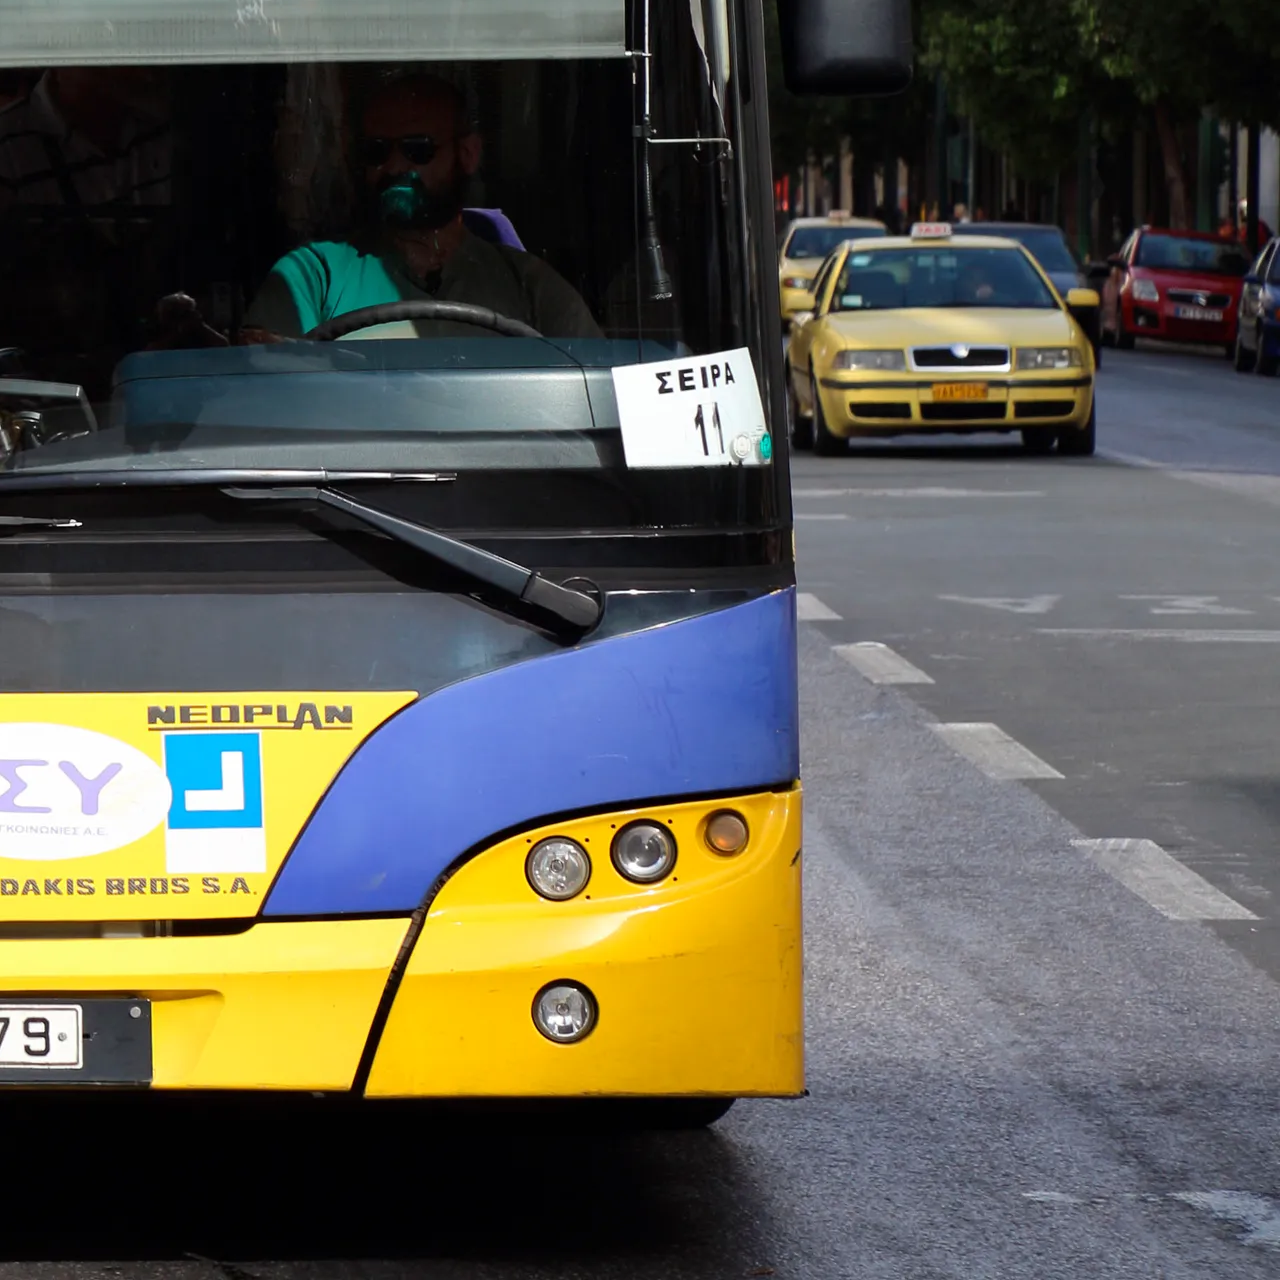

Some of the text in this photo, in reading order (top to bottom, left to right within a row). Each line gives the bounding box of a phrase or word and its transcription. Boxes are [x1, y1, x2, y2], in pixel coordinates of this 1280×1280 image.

[655, 361, 736, 395] ΣΕΙΡΑ
[694, 401, 726, 456] 11
[147, 702, 353, 730] NEOPLAN
[82, 826, 109, 836] Α.Ε.
[105, 877, 190, 896] BROS
[202, 876, 258, 896] S.A.
